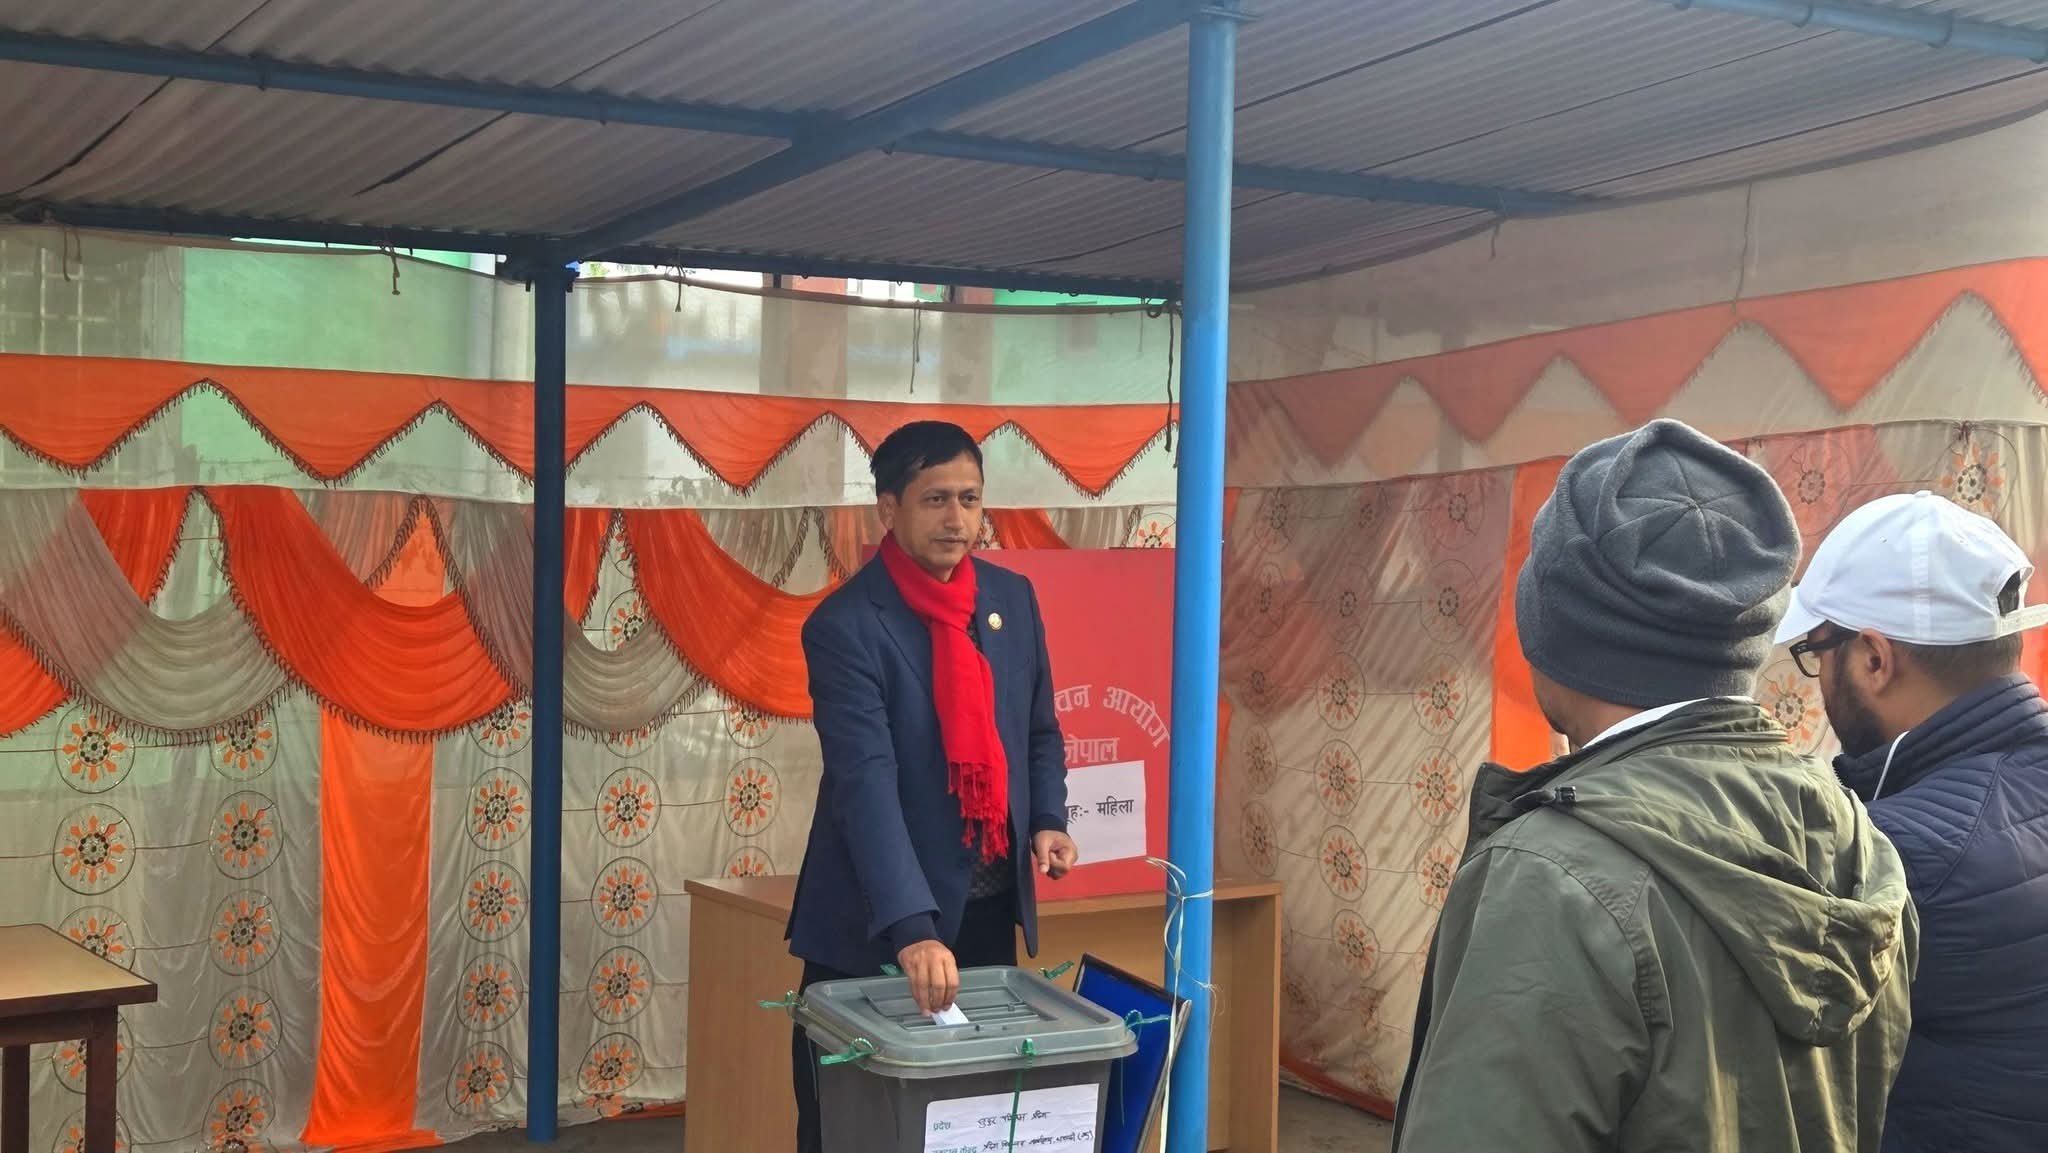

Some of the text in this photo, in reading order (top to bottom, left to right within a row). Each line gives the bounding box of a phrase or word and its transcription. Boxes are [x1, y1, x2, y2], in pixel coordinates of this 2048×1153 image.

[1103, 686, 1170, 748] आयोग
[1096, 795, 1134, 817] महिला
[933, 1120, 951, 1131] प्रदेश
